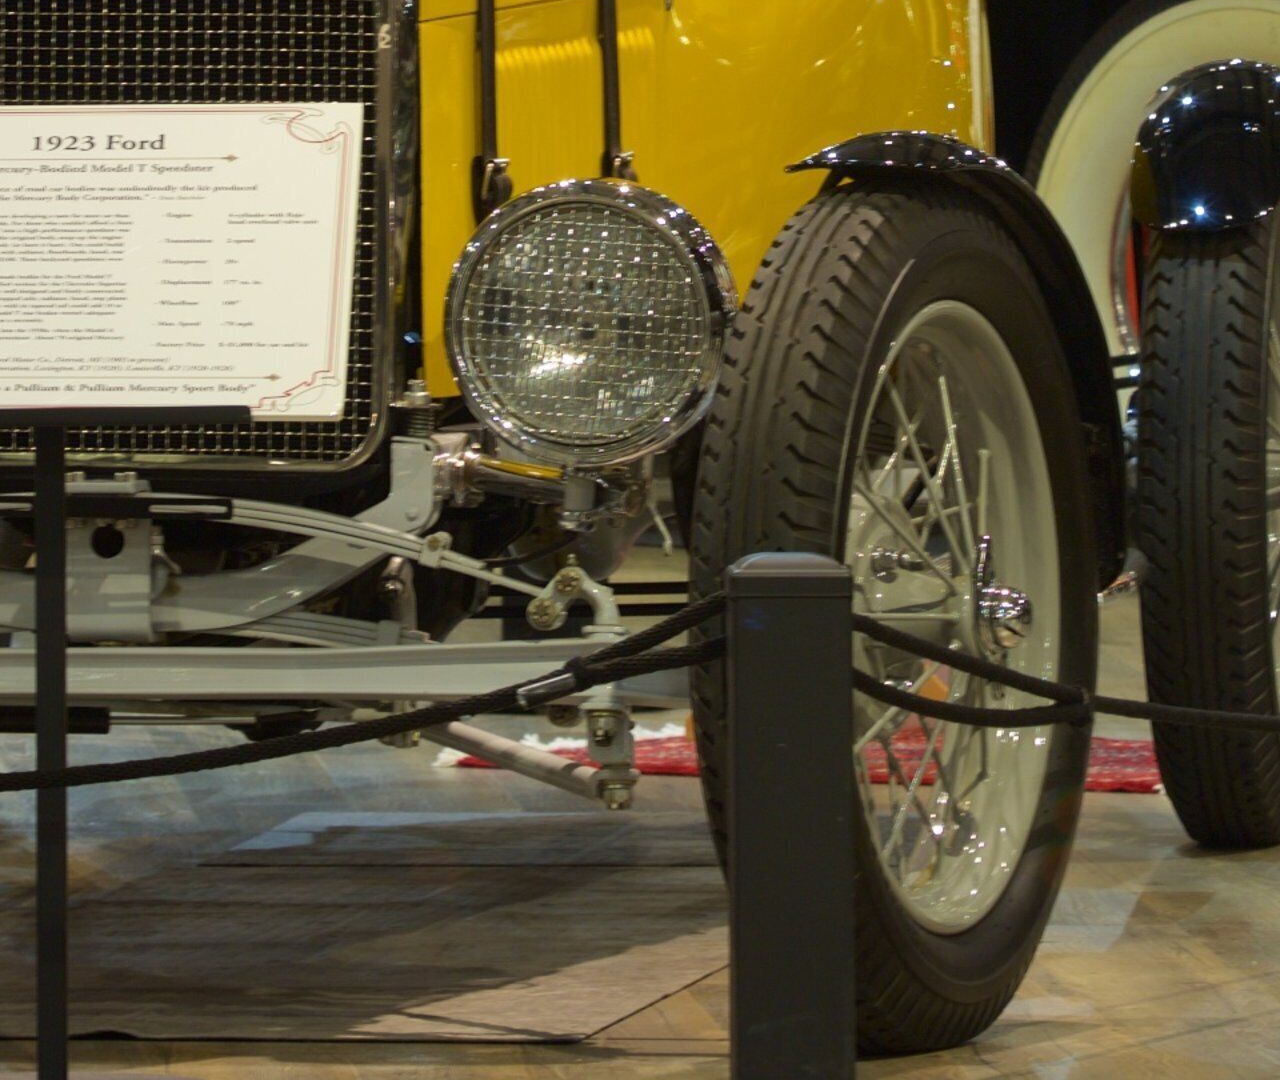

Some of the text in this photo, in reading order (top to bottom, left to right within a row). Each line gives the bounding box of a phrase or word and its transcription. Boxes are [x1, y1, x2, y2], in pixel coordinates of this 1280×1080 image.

[30, 134, 167, 151] 1923 Ford
[89, 164, 135, 173] Model
[136, 164, 148, 172] T
[150, 163, 215, 174] Speedster
[13, 384, 62, 392] Pulliam
[78, 384, 127, 392] Pulliam
[128, 384, 180, 394] Mercury
